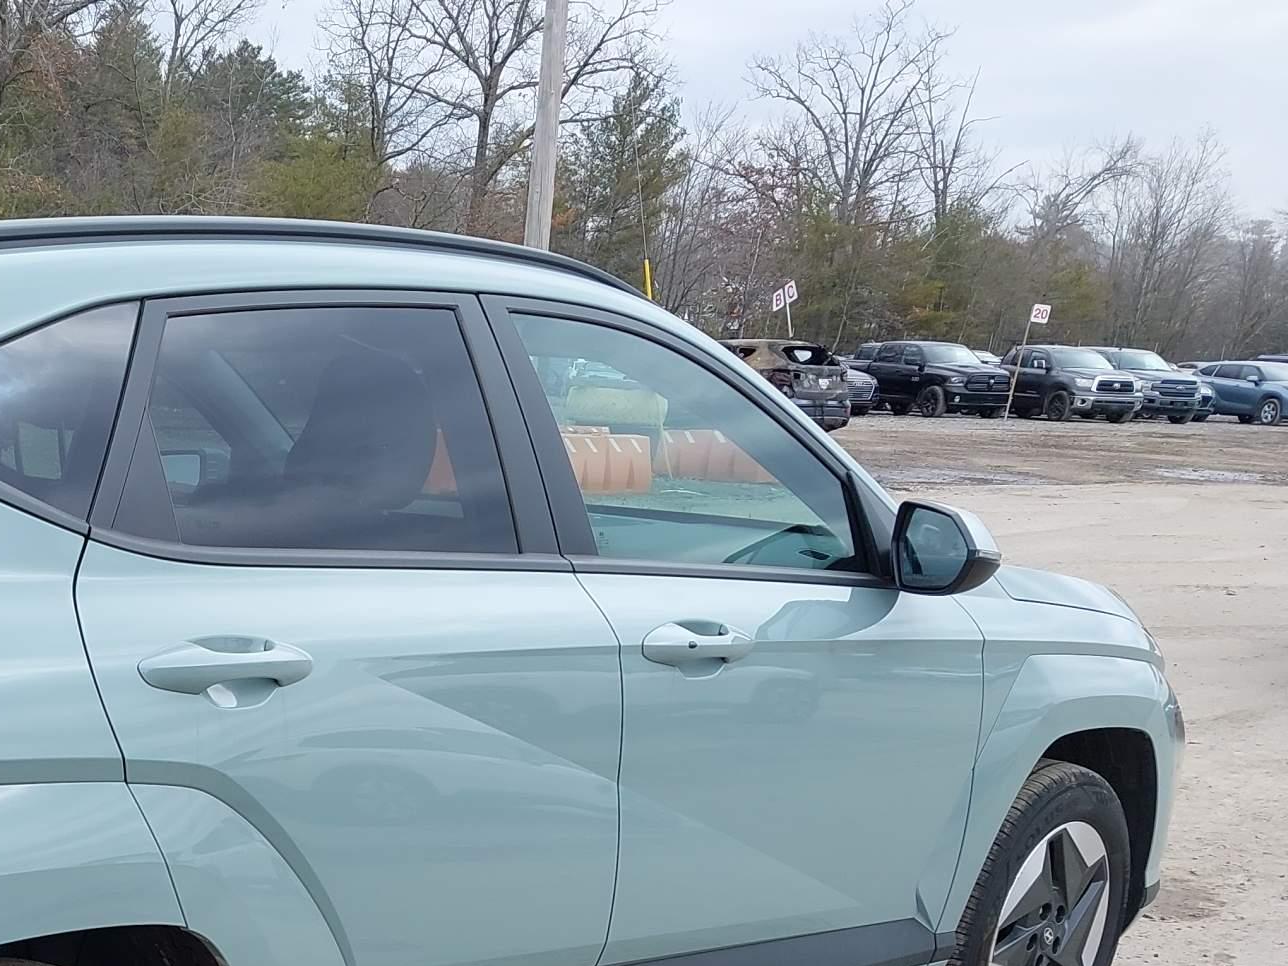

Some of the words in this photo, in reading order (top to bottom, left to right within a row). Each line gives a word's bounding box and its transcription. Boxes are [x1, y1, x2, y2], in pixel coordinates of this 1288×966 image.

[787, 284, 795, 299] C
[775, 292, 782, 307] B
[1033, 307, 1049, 320] 20
